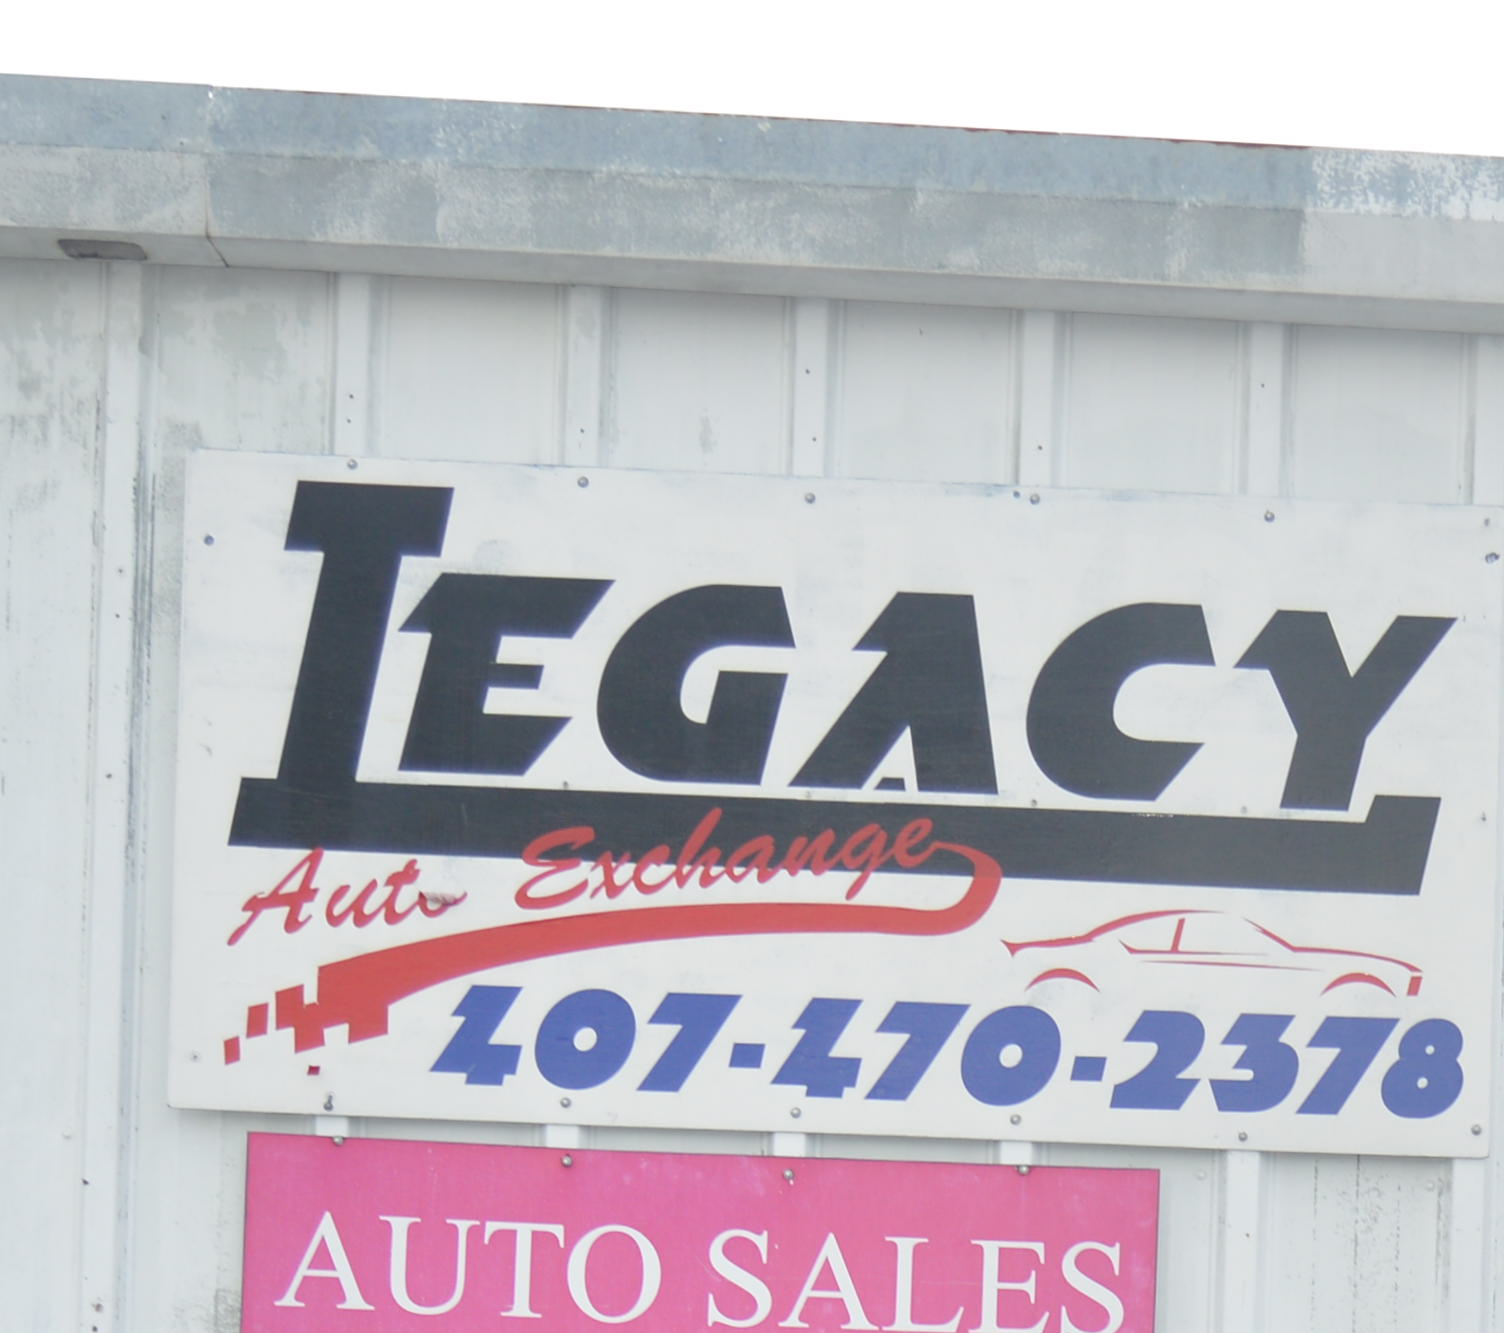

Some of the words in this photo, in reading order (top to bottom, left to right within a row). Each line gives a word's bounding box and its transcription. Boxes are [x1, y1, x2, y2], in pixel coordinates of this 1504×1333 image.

[228, 481, 1458, 895] LEGACY
[227, 847, 467, 946] Auto
[514, 809, 938, 912] Exchange
[430, 985, 1465, 1120] 407-470-2378
[274, 1211, 663, 1324] AUTO
